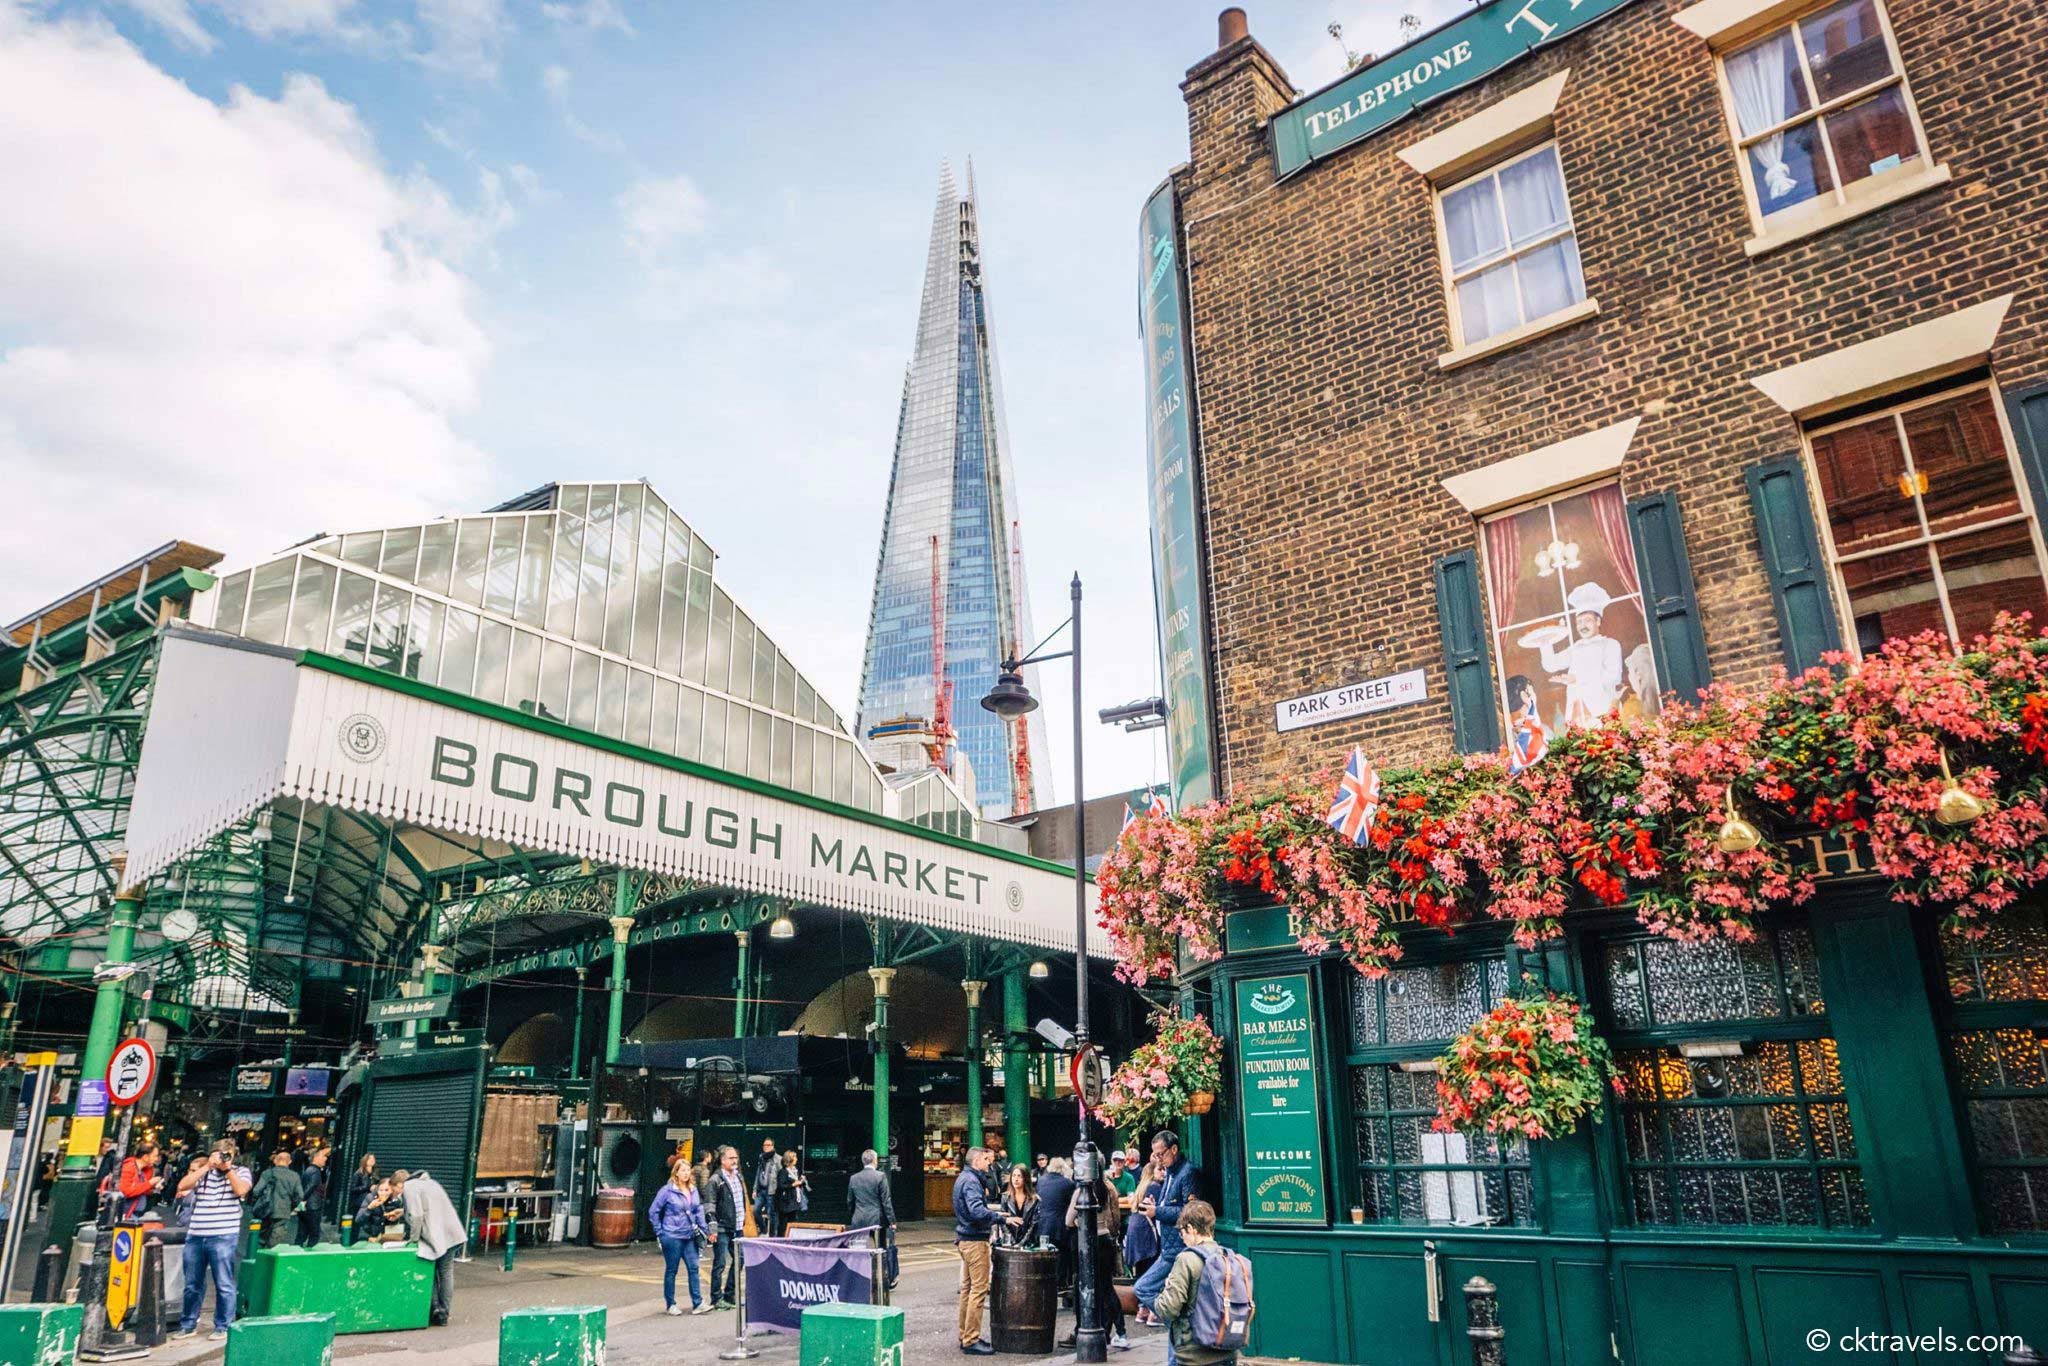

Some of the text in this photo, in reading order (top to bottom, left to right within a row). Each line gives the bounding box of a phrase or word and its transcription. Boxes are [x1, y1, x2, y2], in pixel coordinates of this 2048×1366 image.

[1305, 40, 1473, 139] TELEPHONE
[1289, 681, 1414, 718] PARK STREET SE1
[431, 735, 783, 860] BOROUGH
[810, 830, 989, 905] MARKET
[1261, 983, 1282, 995] THE
[1243, 1018, 1307, 1035] BAR MEALS
[1250, 1033, 1297, 1047] Available
[1245, 1057, 1310, 1074] FUNCTION ROOM
[1257, 1075, 1299, 1089] available for
[1272, 1094, 1287, 1107] hire
[1256, 1150, 1311, 1160] WELCOME
[1256, 1173, 1317, 1197] RESERVATIONS
[1261, 1201, 1312, 1213] 020 7407 2495
